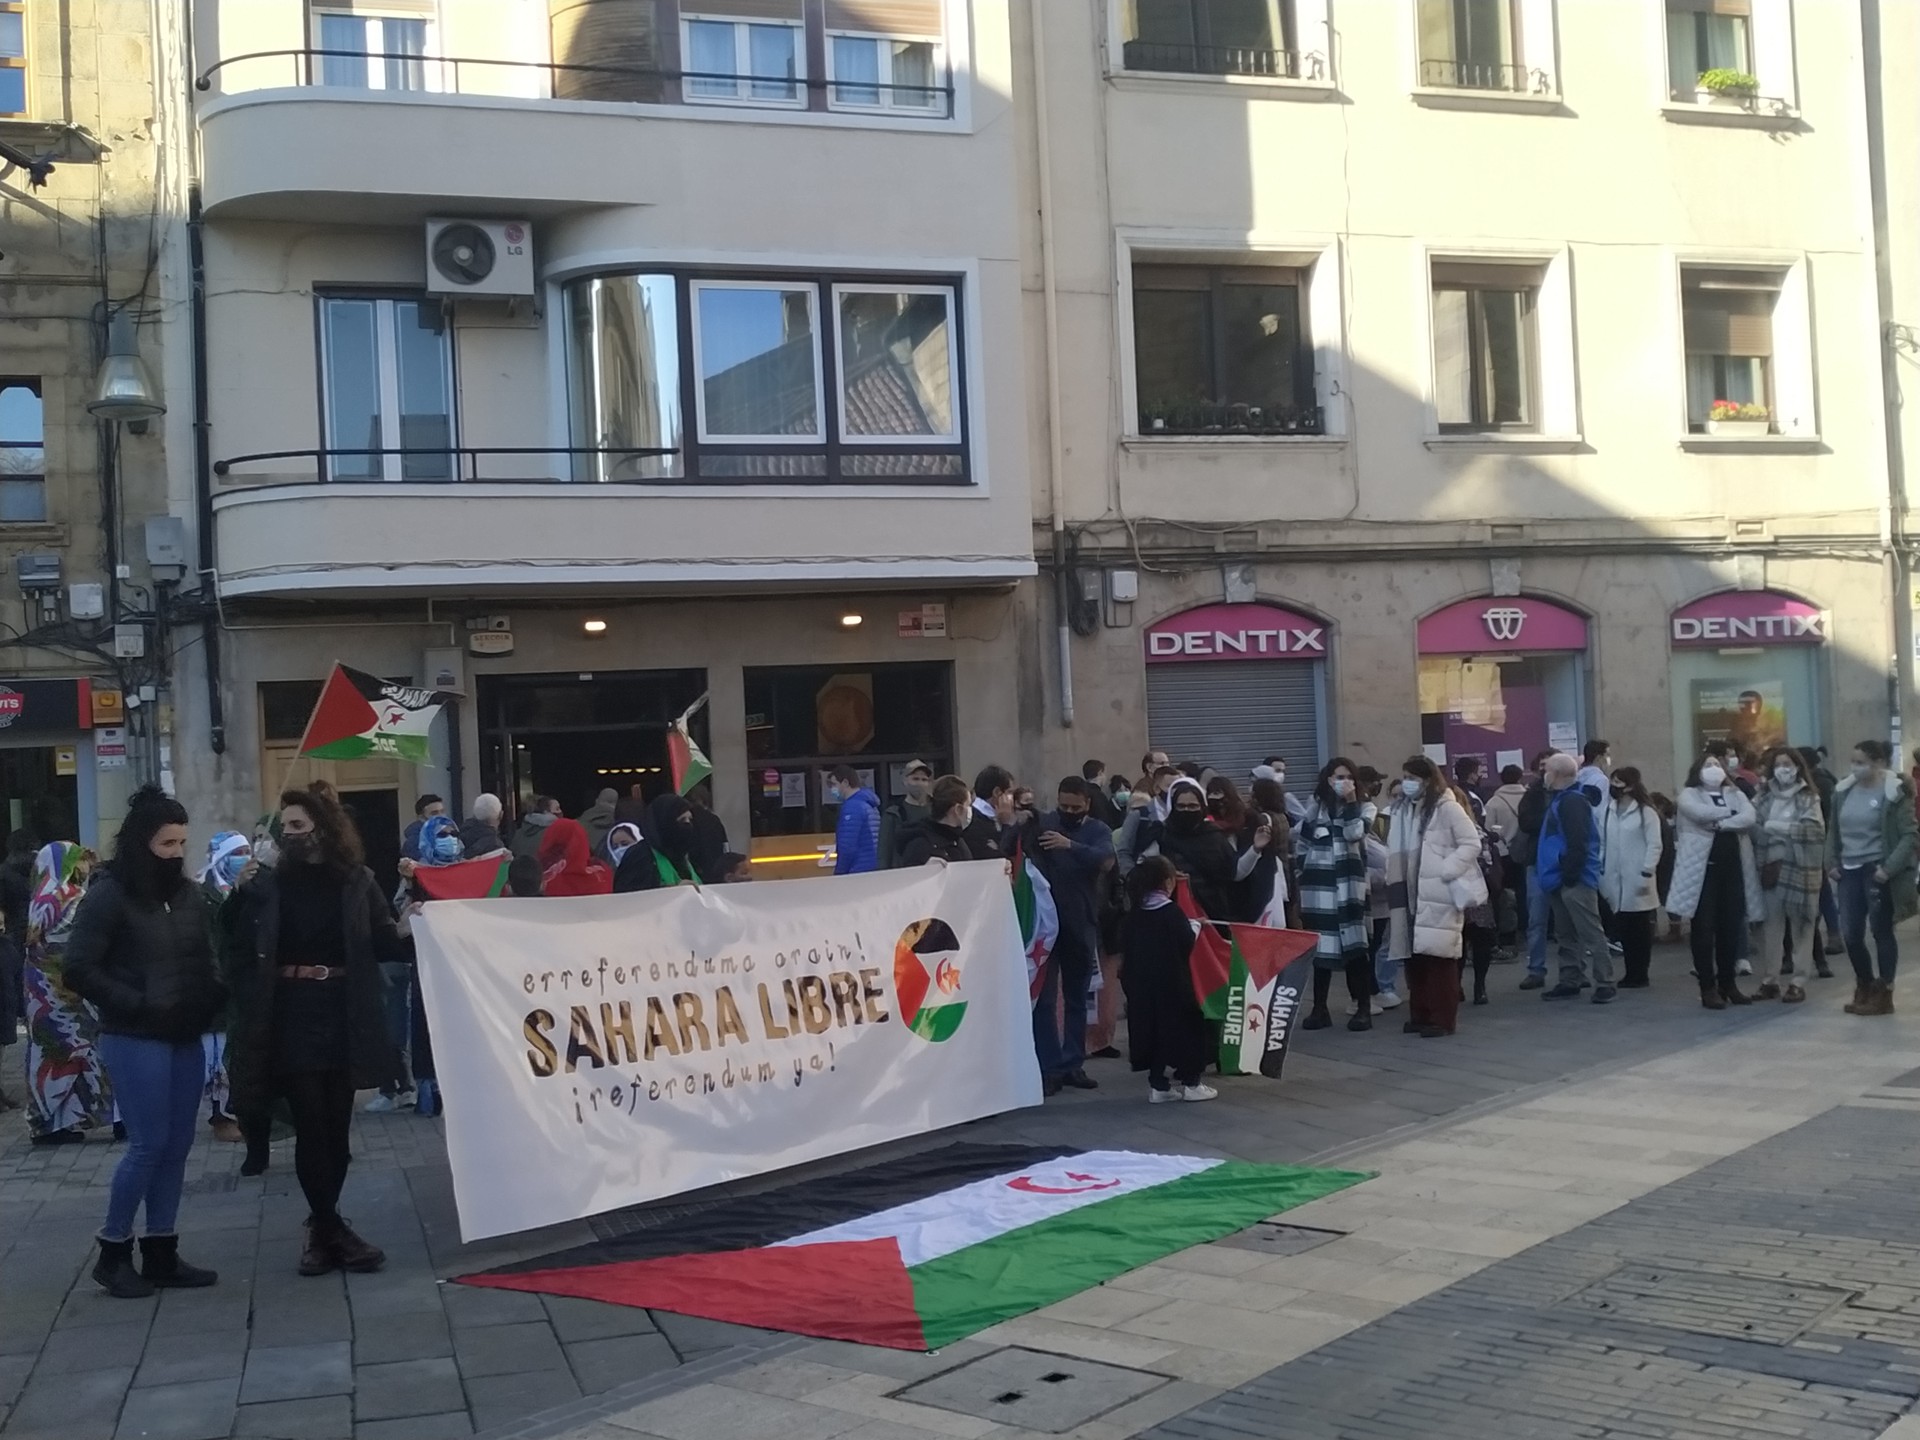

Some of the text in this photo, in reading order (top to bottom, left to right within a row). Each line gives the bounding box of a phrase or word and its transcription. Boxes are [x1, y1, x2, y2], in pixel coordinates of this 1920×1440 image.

[507, 246, 524, 256] LG
[1150, 628, 1325, 655] DENTIX
[1674, 615, 1824, 640] DENTIX
[523, 950, 756, 995] erreferenduma
[523, 967, 890, 1078] SAHARA LIBRE
[1223, 986, 1243, 1045] LLIURE
[793, 1042, 836, 1088] ya!
